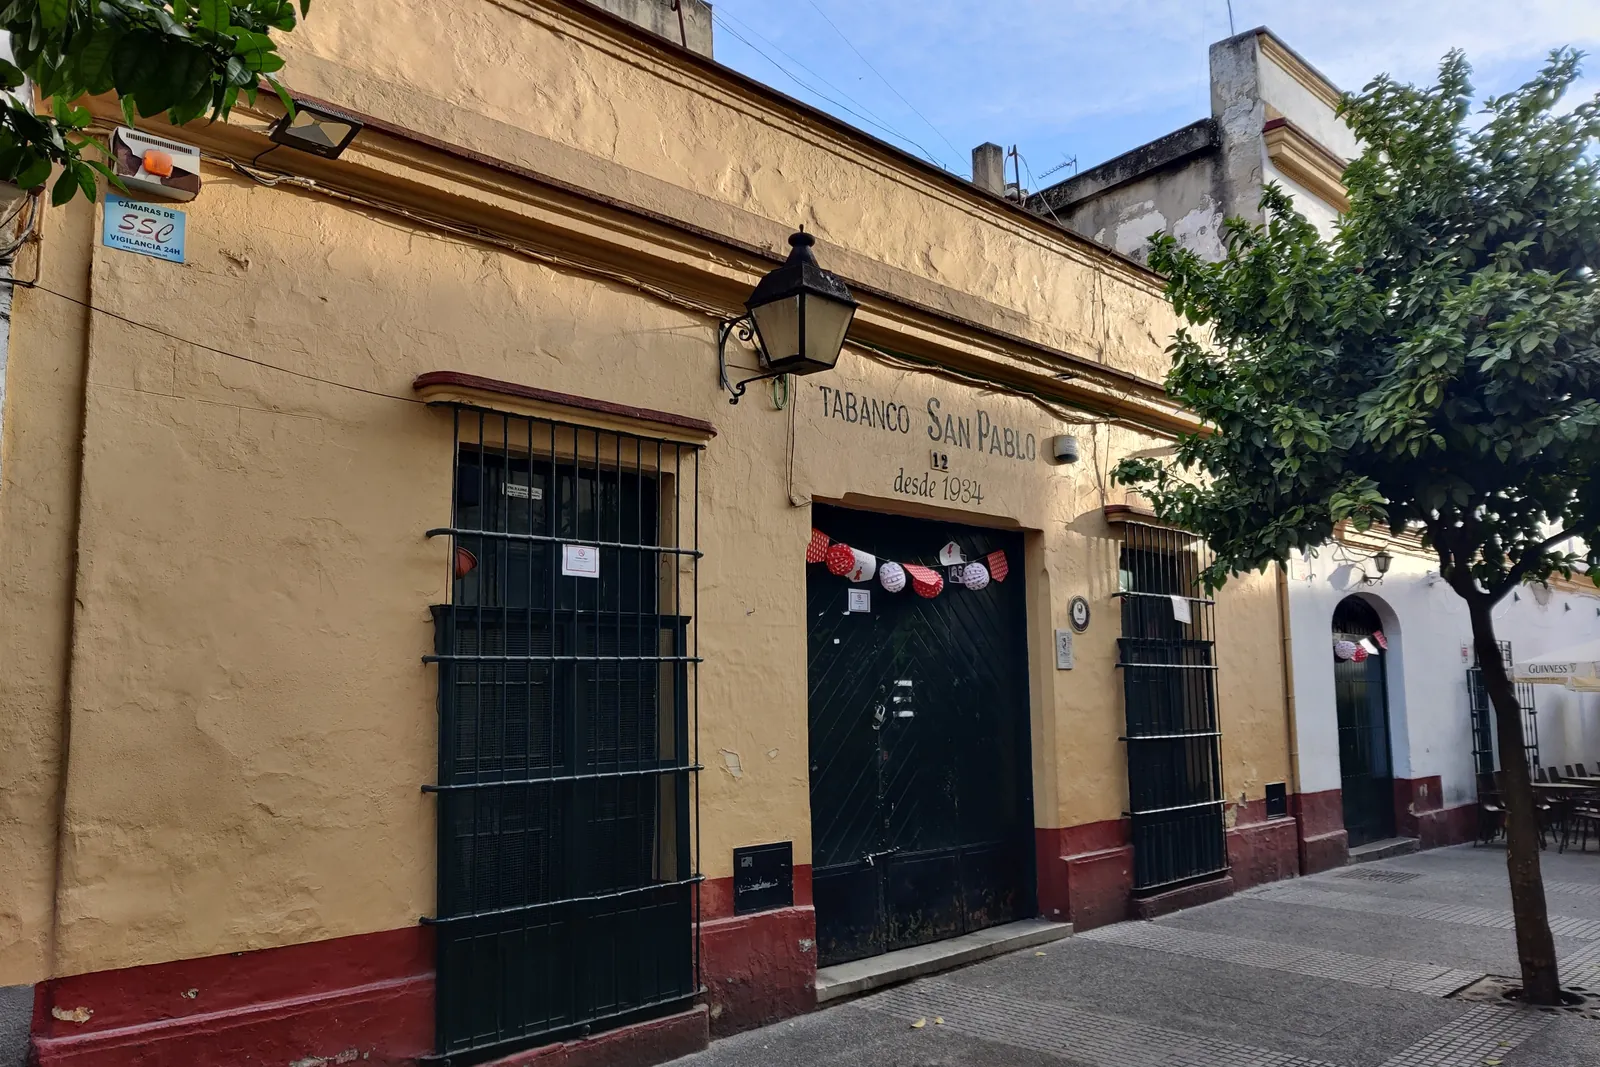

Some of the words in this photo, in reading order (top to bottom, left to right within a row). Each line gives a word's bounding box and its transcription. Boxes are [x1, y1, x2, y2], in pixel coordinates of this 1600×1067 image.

[118, 200, 161, 216] CÁMARAS
[163, 211, 175, 220] DE
[118, 213, 174, 243] SSC
[110, 233, 162, 251] VIGILANCIA
[164, 246, 181, 255] 24H
[819, 386, 910, 434] TABANCO
[927, 397, 971, 448] SAN
[977, 409, 1036, 462] PABLO
[932, 452, 949, 470] 12
[893, 467, 936, 499] desde
[943, 475, 984, 504] 1934
[1528, 663, 1568, 675] GUINNESS
